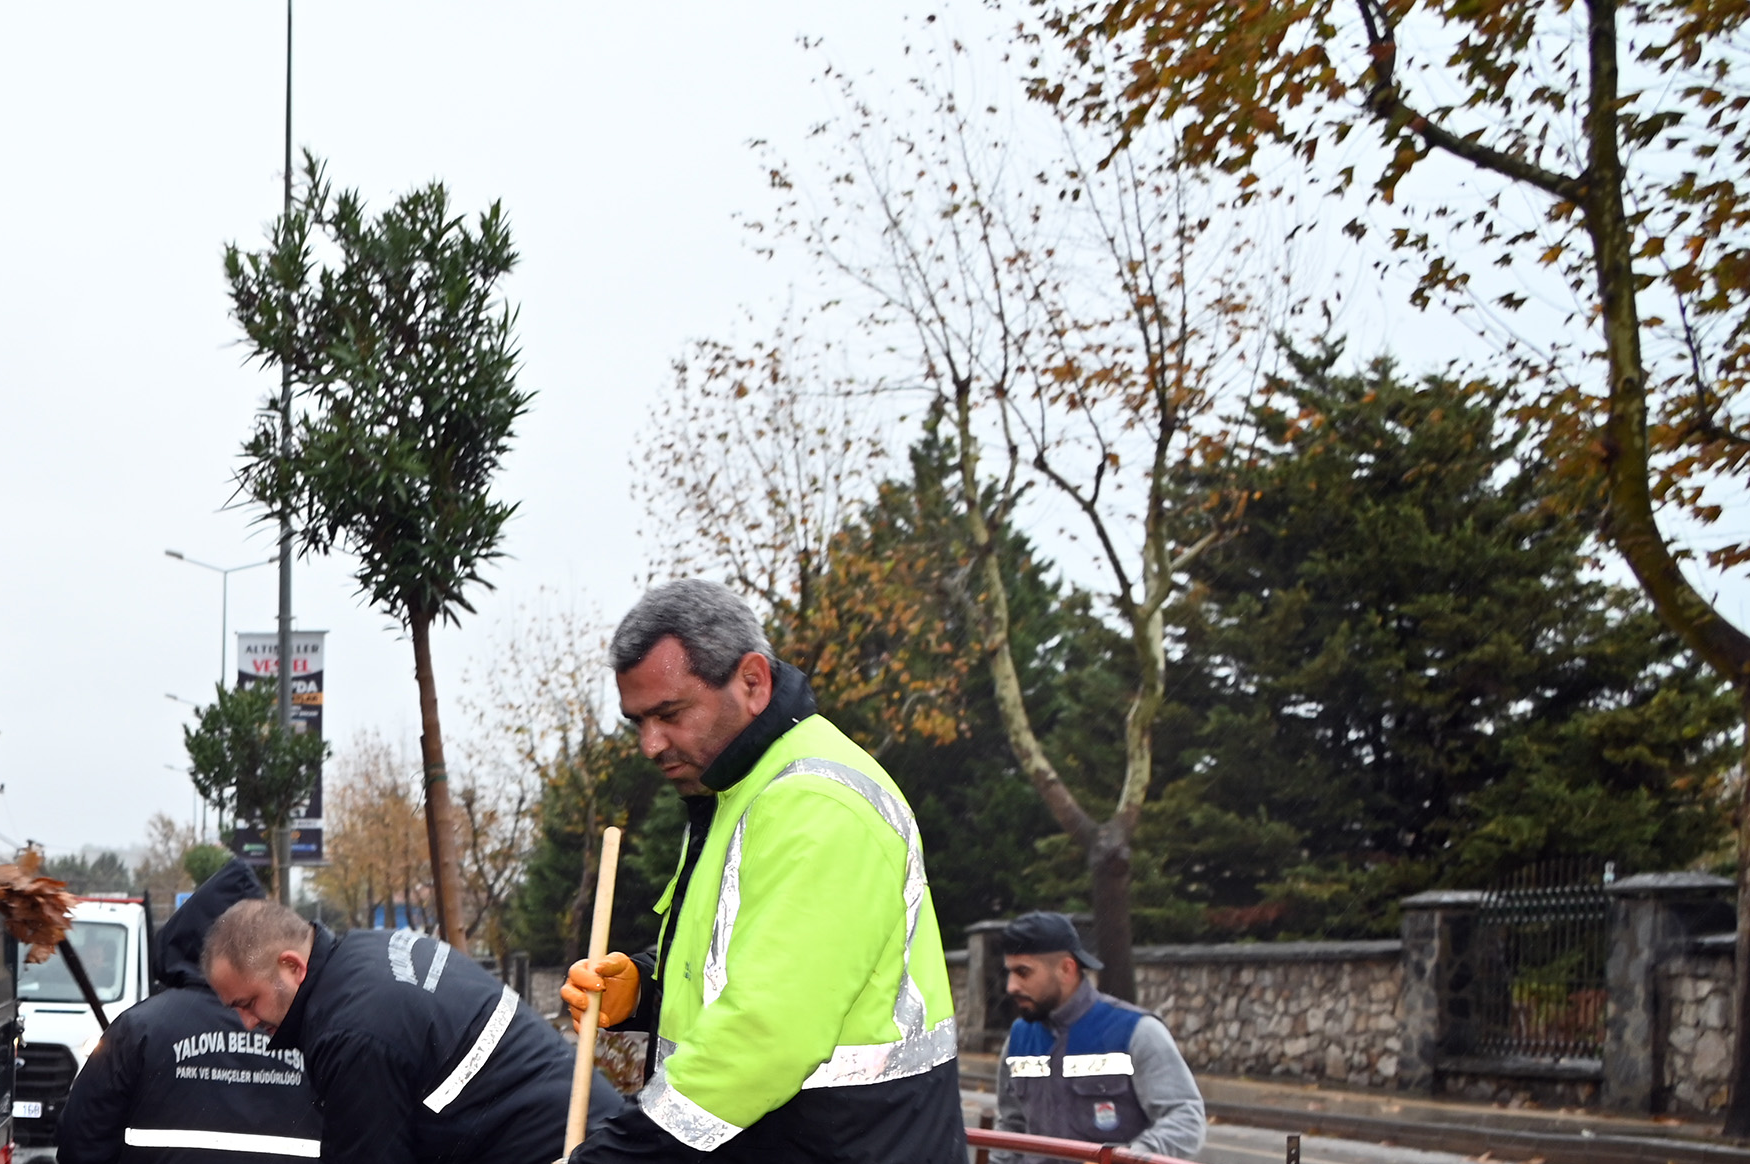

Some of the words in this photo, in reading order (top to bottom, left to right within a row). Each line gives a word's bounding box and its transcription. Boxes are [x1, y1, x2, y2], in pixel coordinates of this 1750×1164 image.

[253, 658, 312, 673] VESEL
[173, 1031, 225, 1063] YALOVA
[176, 1066, 197, 1079] PARK
[200, 1066, 210, 1080] VE
[211, 1068, 251, 1084] BAHÇELER
[253, 1069, 302, 1087] MÜDÜRLÜĞÜ
